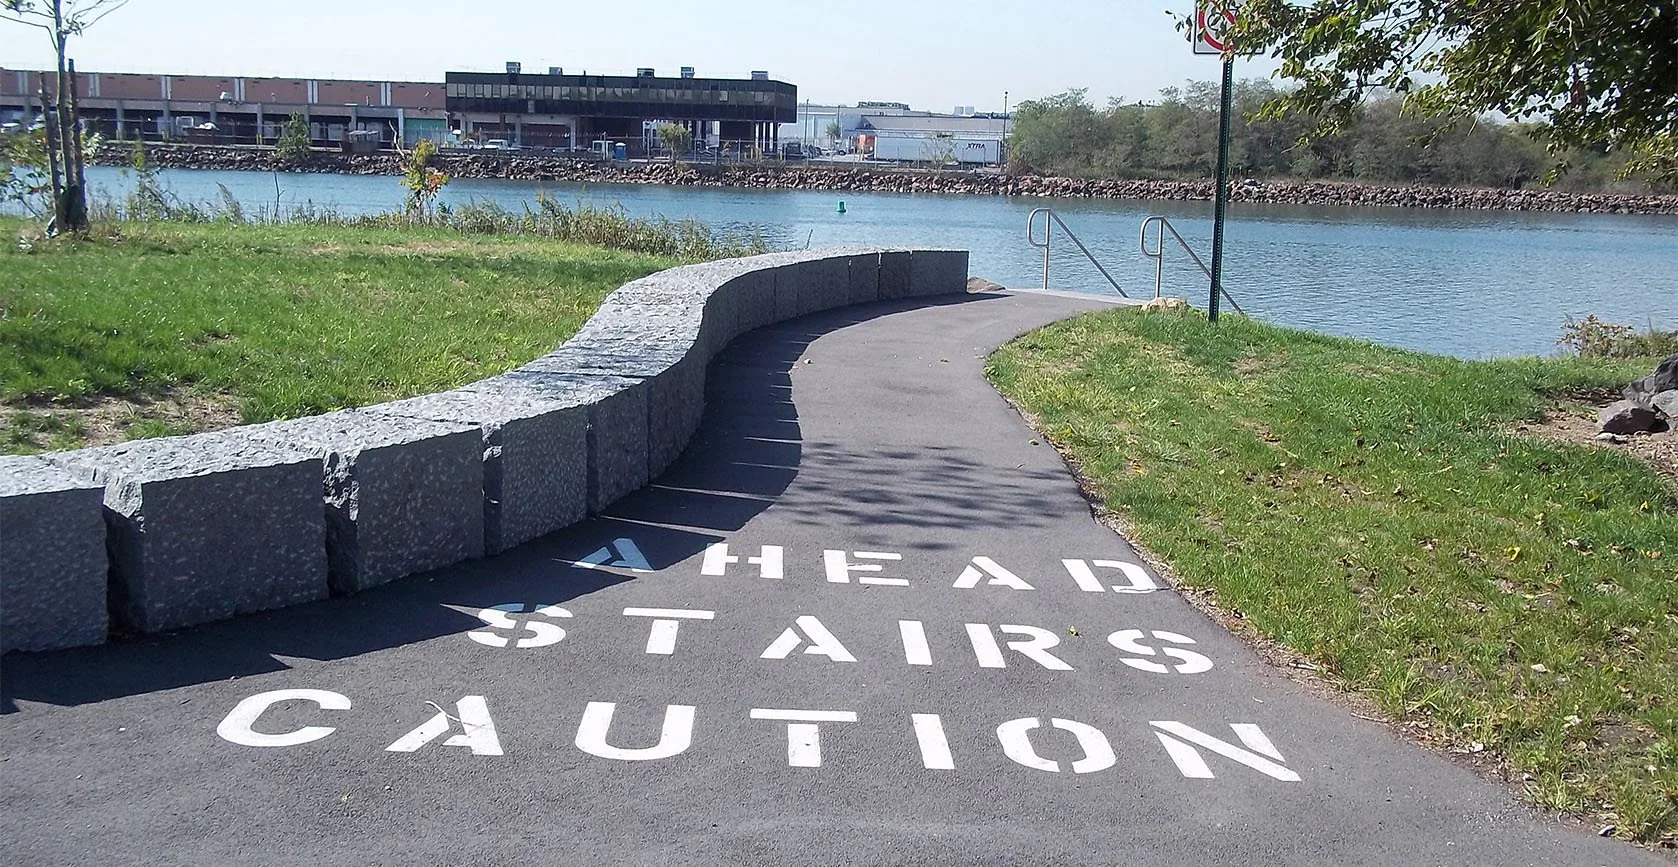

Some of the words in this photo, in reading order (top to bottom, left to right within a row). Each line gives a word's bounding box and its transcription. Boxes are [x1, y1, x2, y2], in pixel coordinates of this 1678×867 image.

[965, 142, 986, 150] XTRA
[570, 538, 1161, 594] AHEAD
[467, 602, 1214, 674] STAIRS
[216, 688, 1302, 782] CAUTION
